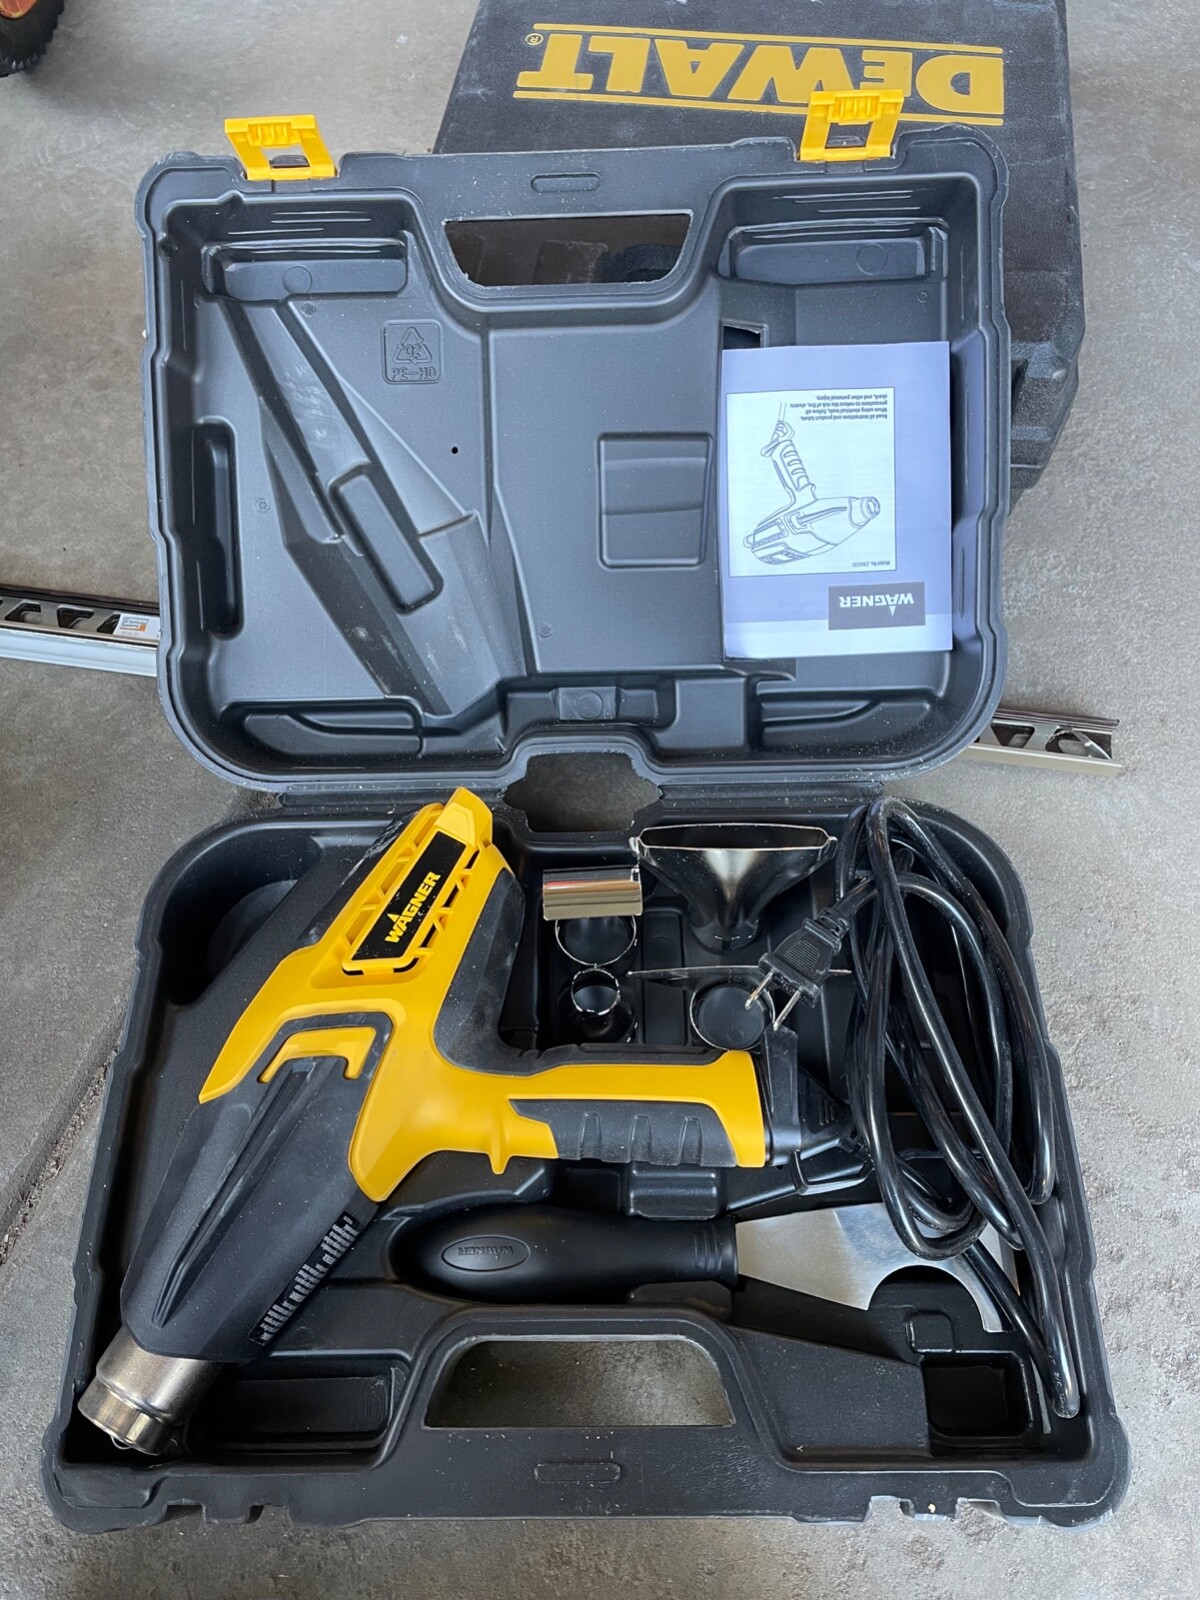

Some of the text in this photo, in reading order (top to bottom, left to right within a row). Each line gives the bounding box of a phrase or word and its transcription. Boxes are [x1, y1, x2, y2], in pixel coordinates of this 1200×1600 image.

[517, 33, 1004, 114] DEWALT
[838, 593, 915, 612] WAGNER
[384, 871, 442, 943] WAGNER
